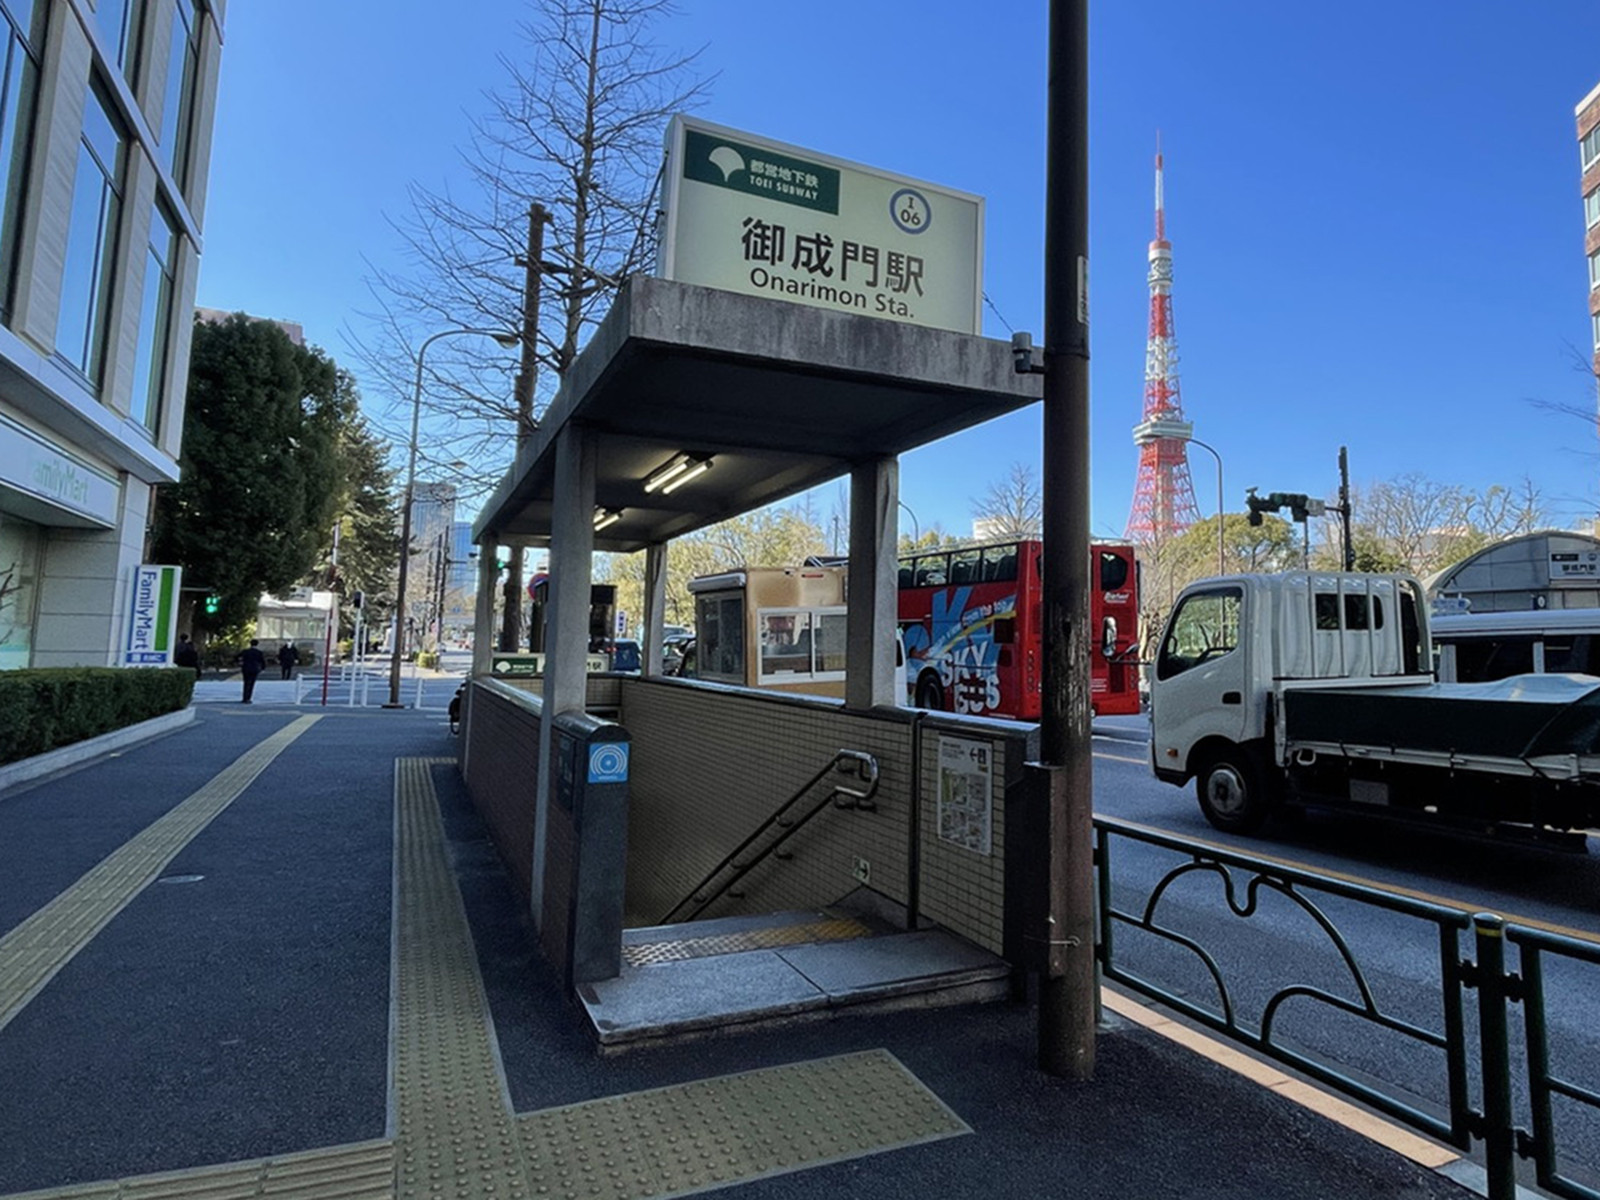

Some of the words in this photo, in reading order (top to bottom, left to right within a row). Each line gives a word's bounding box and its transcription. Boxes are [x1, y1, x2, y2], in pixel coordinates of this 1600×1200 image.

[749, 174, 773, 190] TOEI
[776, 181, 818, 200] SUBWAY
[750, 159, 819, 189] 都営地下鉄
[900, 208, 921, 226] 06
[741, 216, 924, 297] 御成門駅
[750, 267, 867, 309] Onarimon
[875, 292, 915, 319] Sta.
[135, 571, 158, 650] FamilyMart
